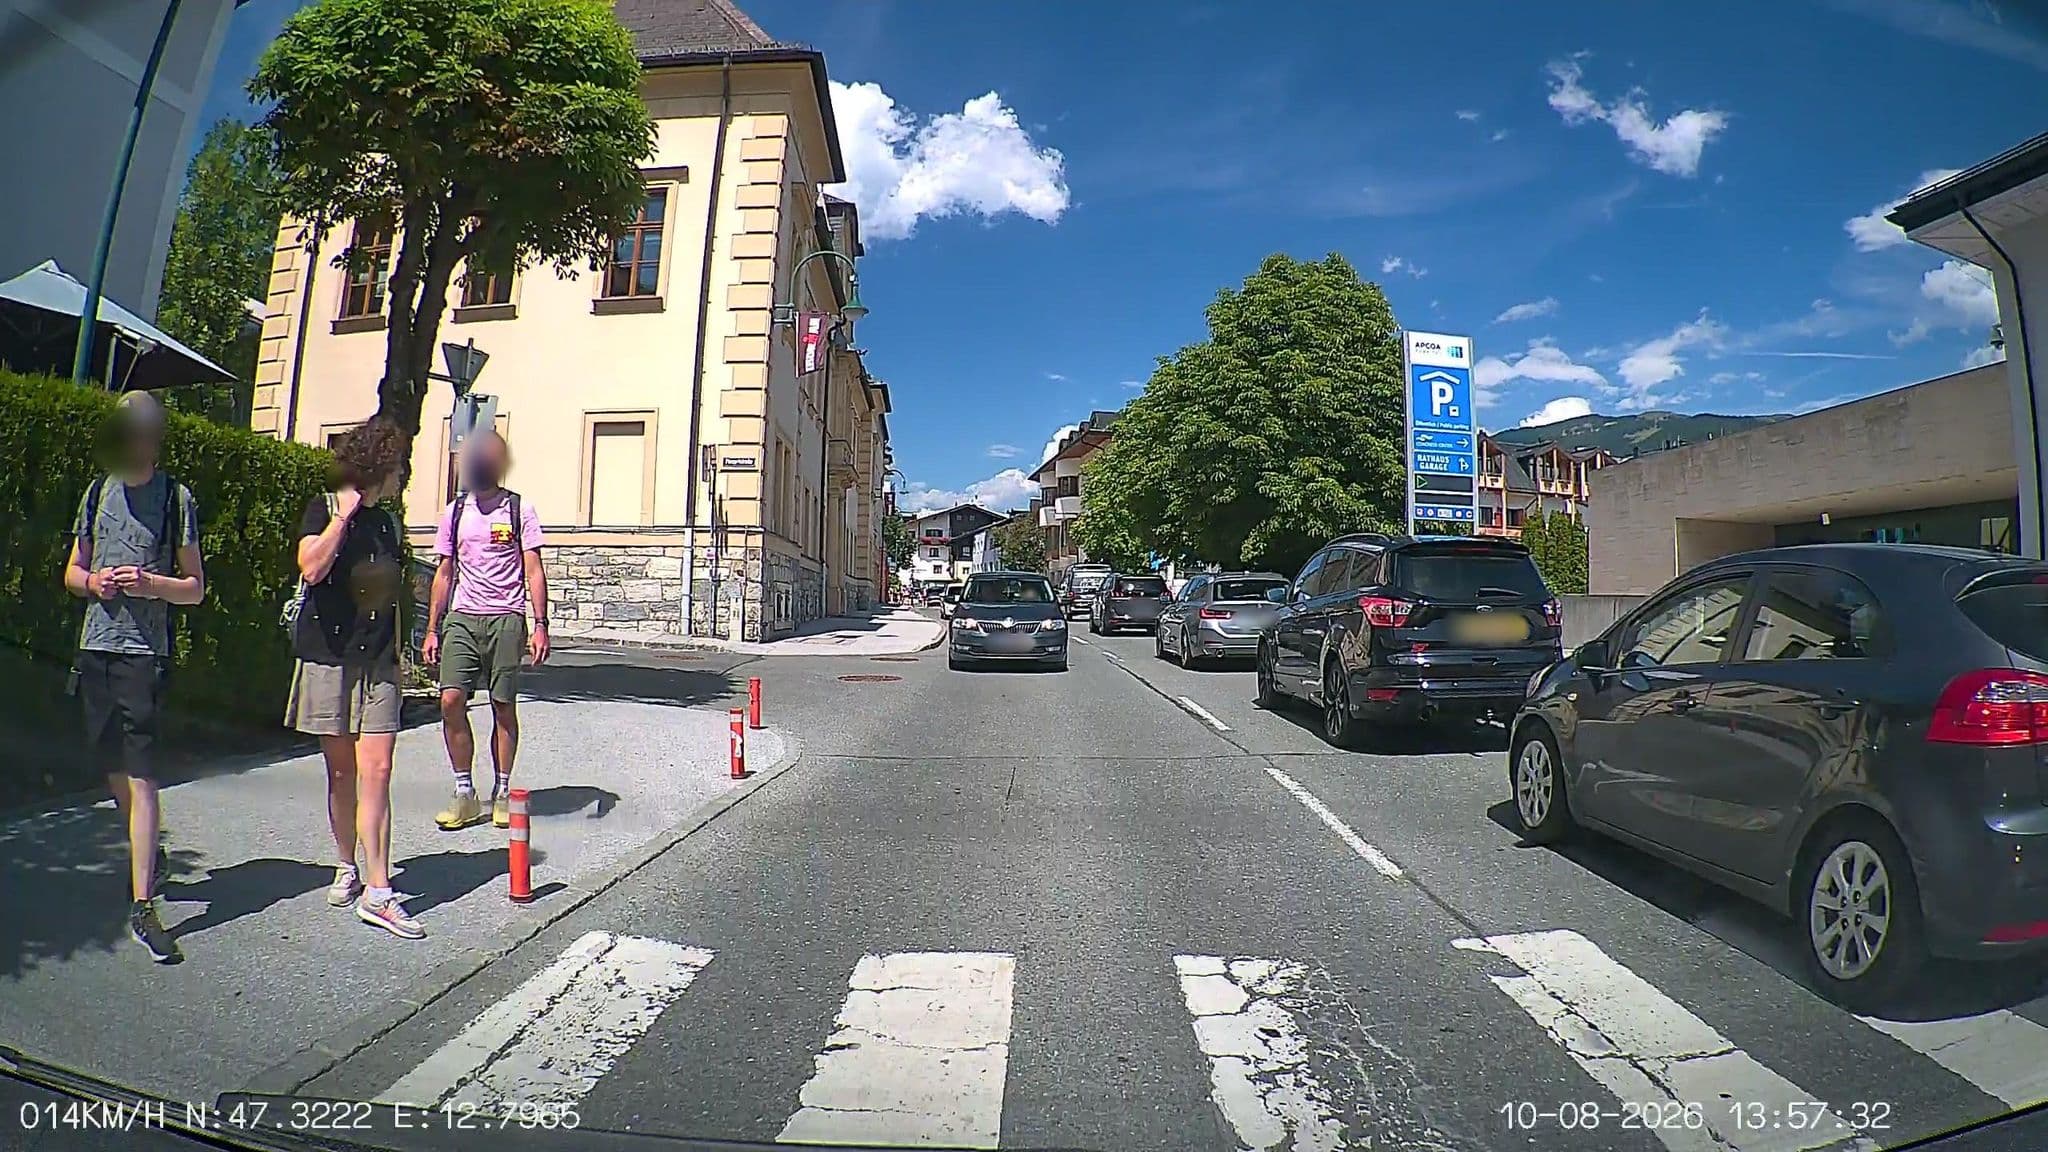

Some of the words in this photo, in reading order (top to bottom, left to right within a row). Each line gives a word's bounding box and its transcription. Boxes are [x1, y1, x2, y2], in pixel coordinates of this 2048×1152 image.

[1432, 381, 1453, 415] P
[1417, 455, 1450, 463] RATHAUS
[1420, 462, 1448, 471] GARAGE
